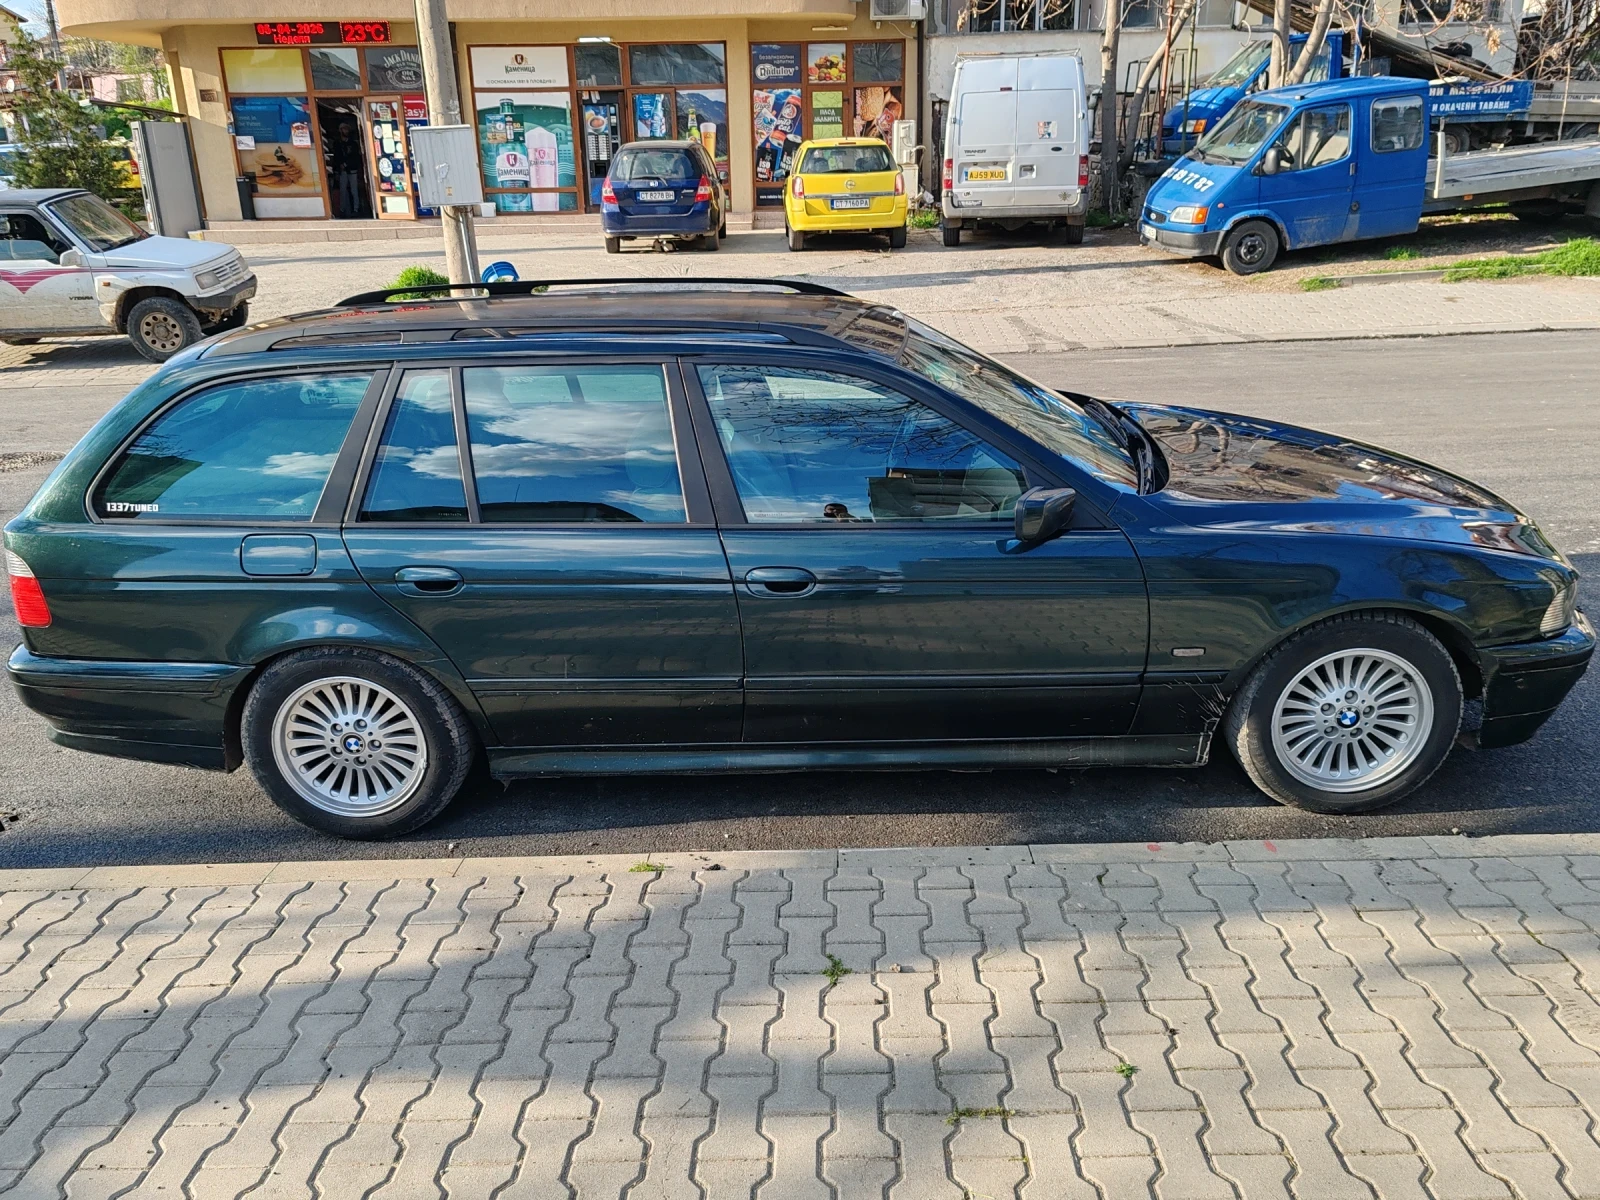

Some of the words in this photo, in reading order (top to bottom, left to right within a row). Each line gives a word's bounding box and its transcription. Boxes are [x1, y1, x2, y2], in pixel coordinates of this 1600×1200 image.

[273, 34, 311, 44] Неделя
[383, 53, 401, 68] JACK
[504, 65, 536, 74] Каменица
[1432, 103, 1438, 112] И
[1440, 101, 1476, 111] ОКАЧЕНИ
[1479, 101, 1510, 110] ТАВАНИ
